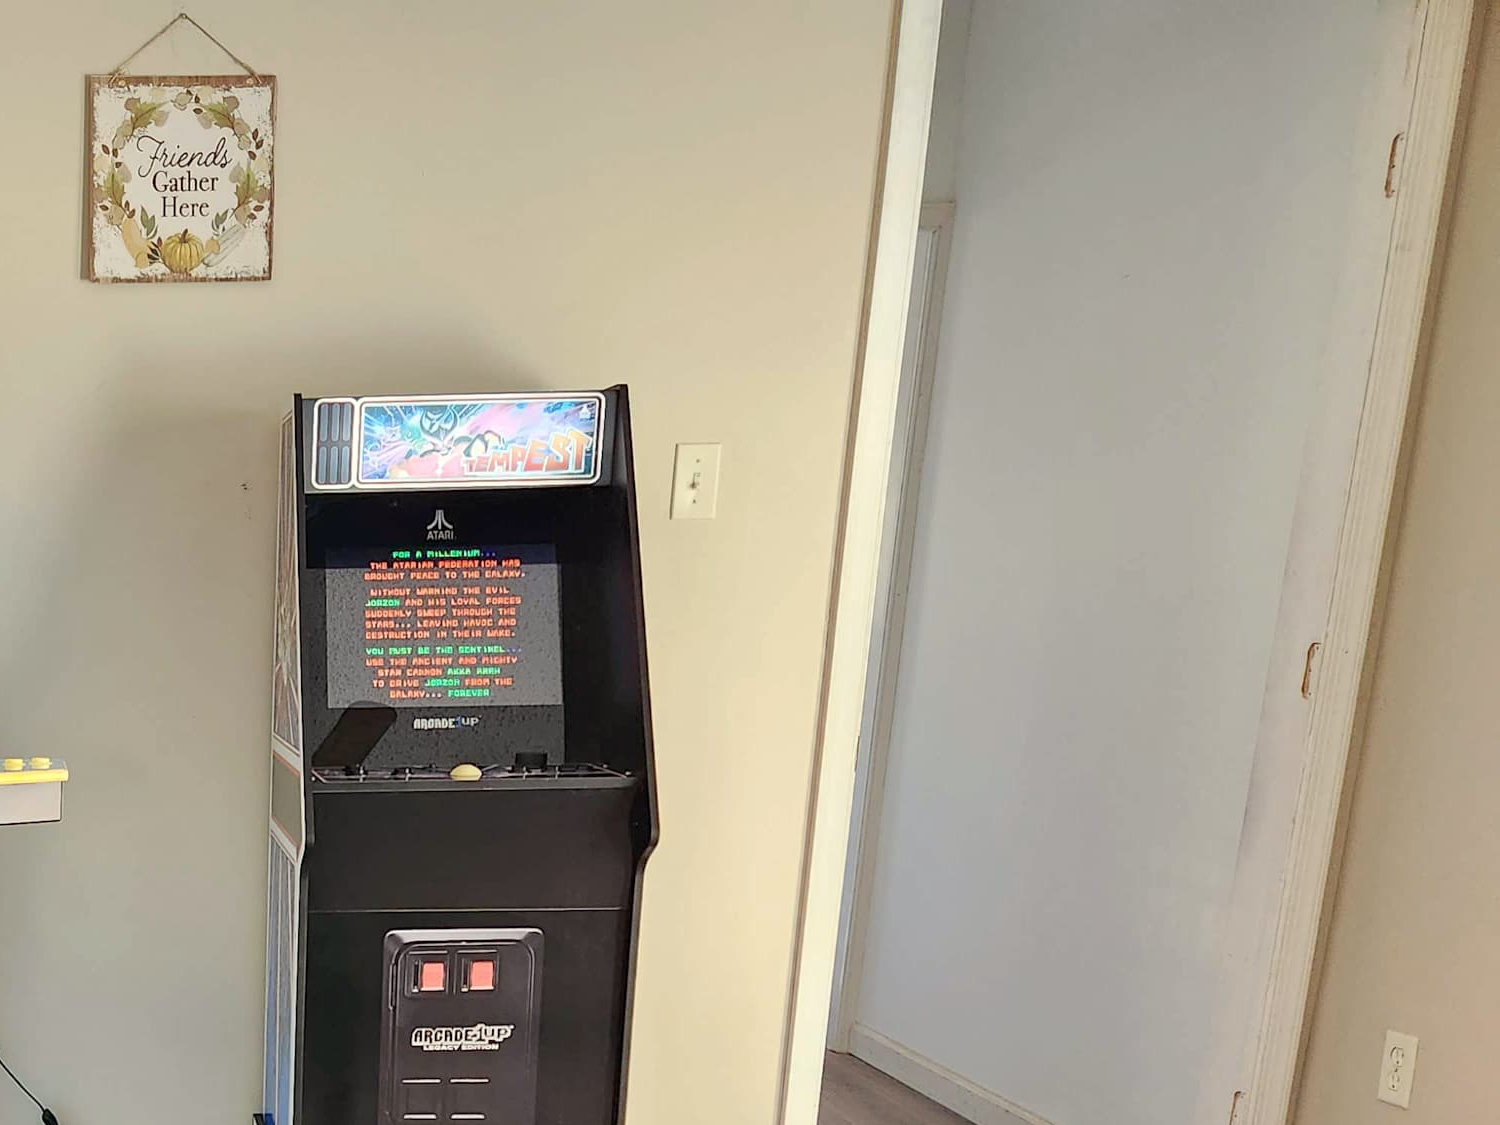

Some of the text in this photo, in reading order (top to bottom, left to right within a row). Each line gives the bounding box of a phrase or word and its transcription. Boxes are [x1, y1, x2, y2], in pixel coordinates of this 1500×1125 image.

[136, 135, 232, 178] Friends
[152, 170, 219, 192] Gather
[161, 196, 210, 217] Here
[463, 428, 592, 474] TEMPEST
[426, 530, 454, 541] ATARI
[439, 560, 497, 568] FEDERATION
[502, 559, 520, 567] HAS
[364, 572, 405, 580] BROUGHT
[370, 588, 411, 596] WITHOUT
[416, 587, 457, 595] WARNING
[485, 586, 509, 594] EVIL
[485, 597, 521, 605] FORCES
[452, 608, 492, 616] THROUGH
[498, 618, 516, 626] AND
[366, 631, 430, 639] DESTRUCTION
[453, 630, 481, 638] THEIR
[389, 647, 412, 655] MUST
[436, 646, 453, 654] THE
[389, 658, 407, 666] THE
[412, 657, 453, 665] ANCIENT
[458, 656, 477, 664] AND
[481, 656, 517, 664] MIGHTY
[372, 680, 385, 688] TO
[464, 678, 490, 686] FROM
[448, 689, 490, 697] FOREVER
